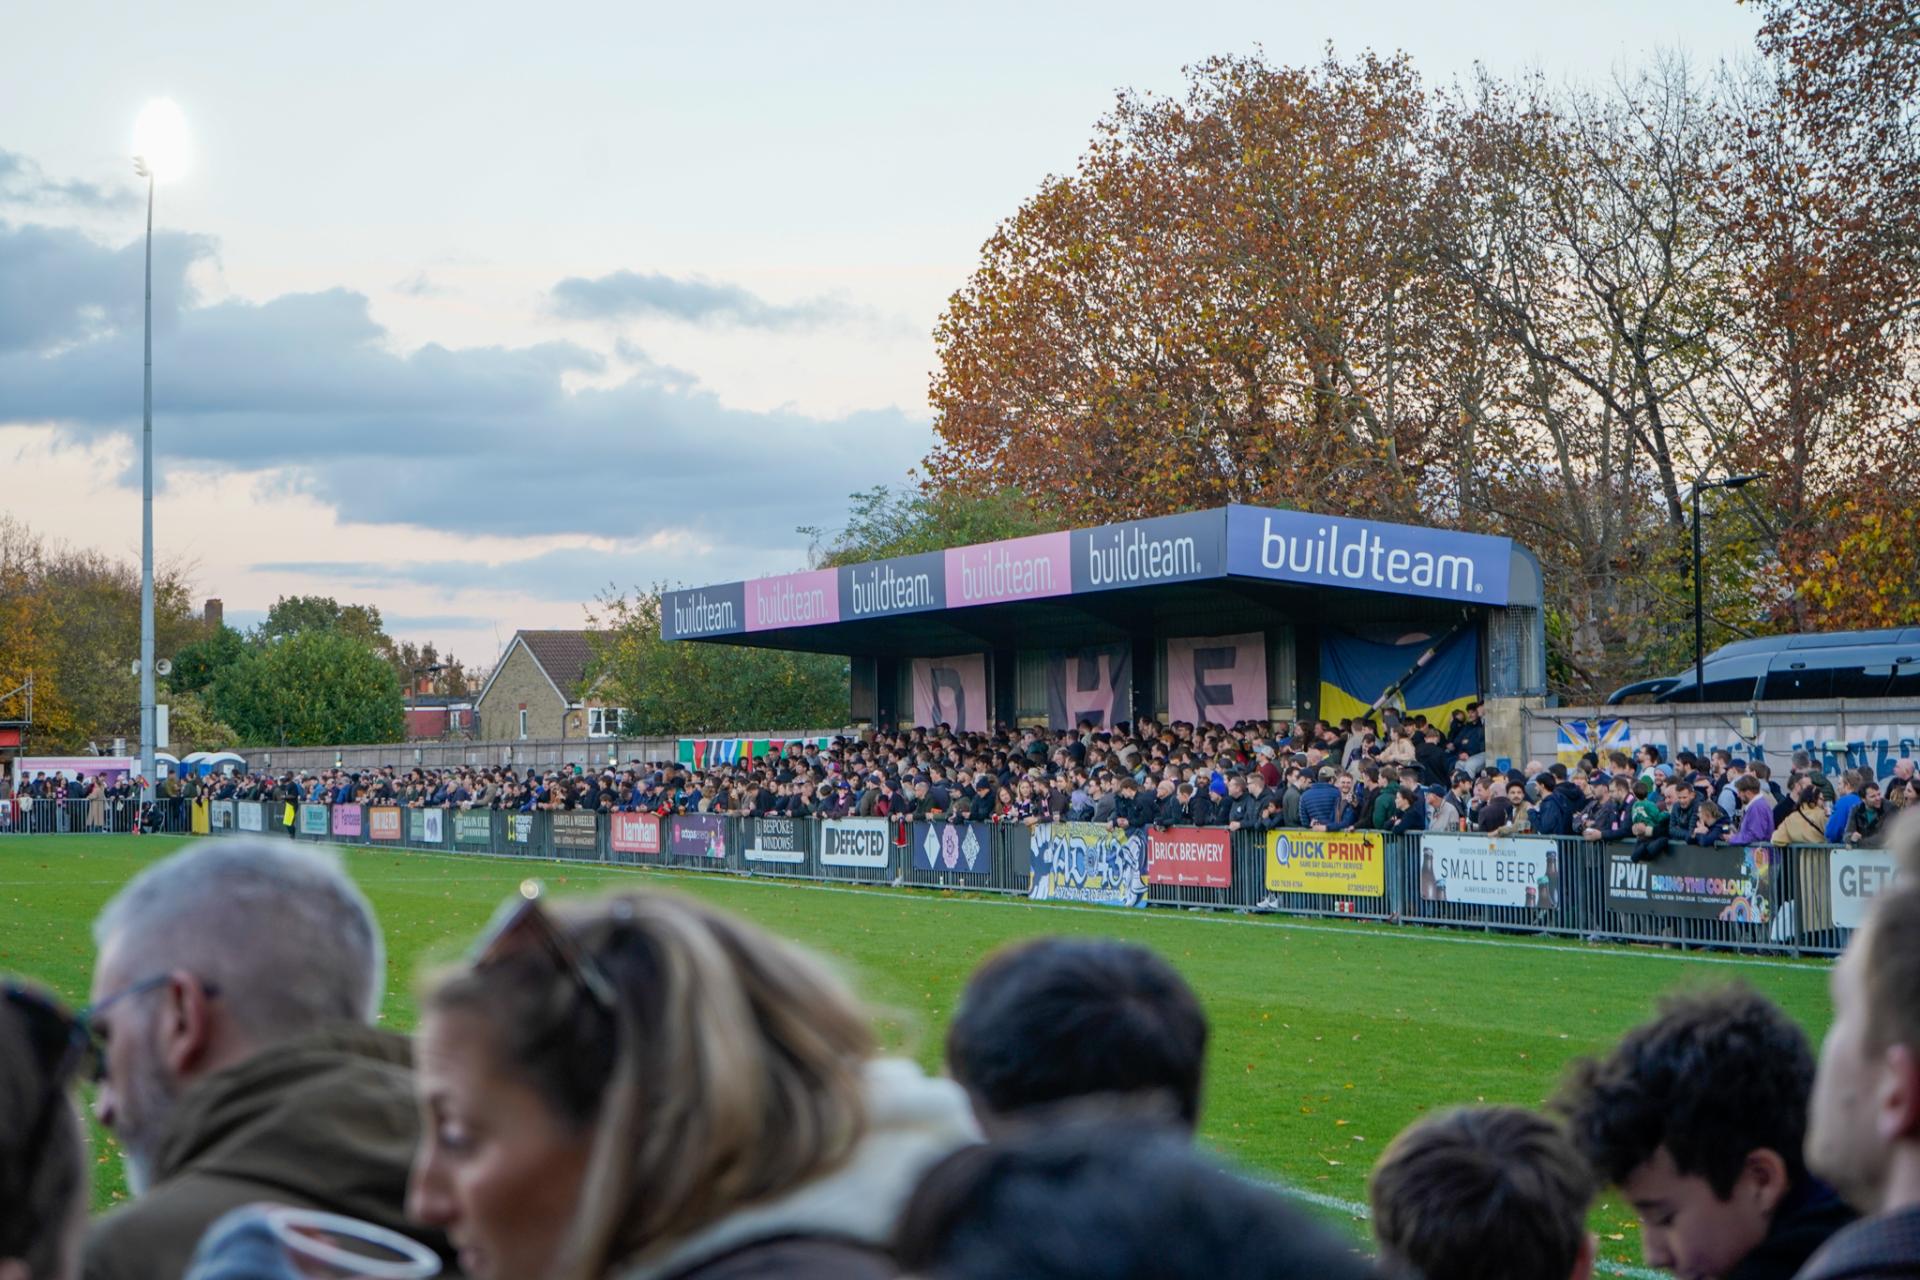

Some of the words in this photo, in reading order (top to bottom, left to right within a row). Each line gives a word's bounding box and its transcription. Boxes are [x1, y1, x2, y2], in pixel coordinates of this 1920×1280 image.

[623, 815, 656, 842] harnham
[763, 819, 790, 834] BESPOKE
[763, 836, 790, 851] WINDOWS
[825, 827, 884, 857] DEFECTED
[1155, 842, 1179, 861] BRICK
[1180, 843, 1224, 862] BREWERY
[1276, 834, 1324, 868] QUICK
[1328, 843, 1374, 861] PRINT
[1343, 862, 1363, 870] SERVICE
[1441, 857, 1488, 881] SMALL
[1496, 861, 1536, 884] BEER
[1610, 862, 1648, 889] IPW1
[1651, 875, 1684, 892] BRING
[1685, 876, 1705, 893] THE
